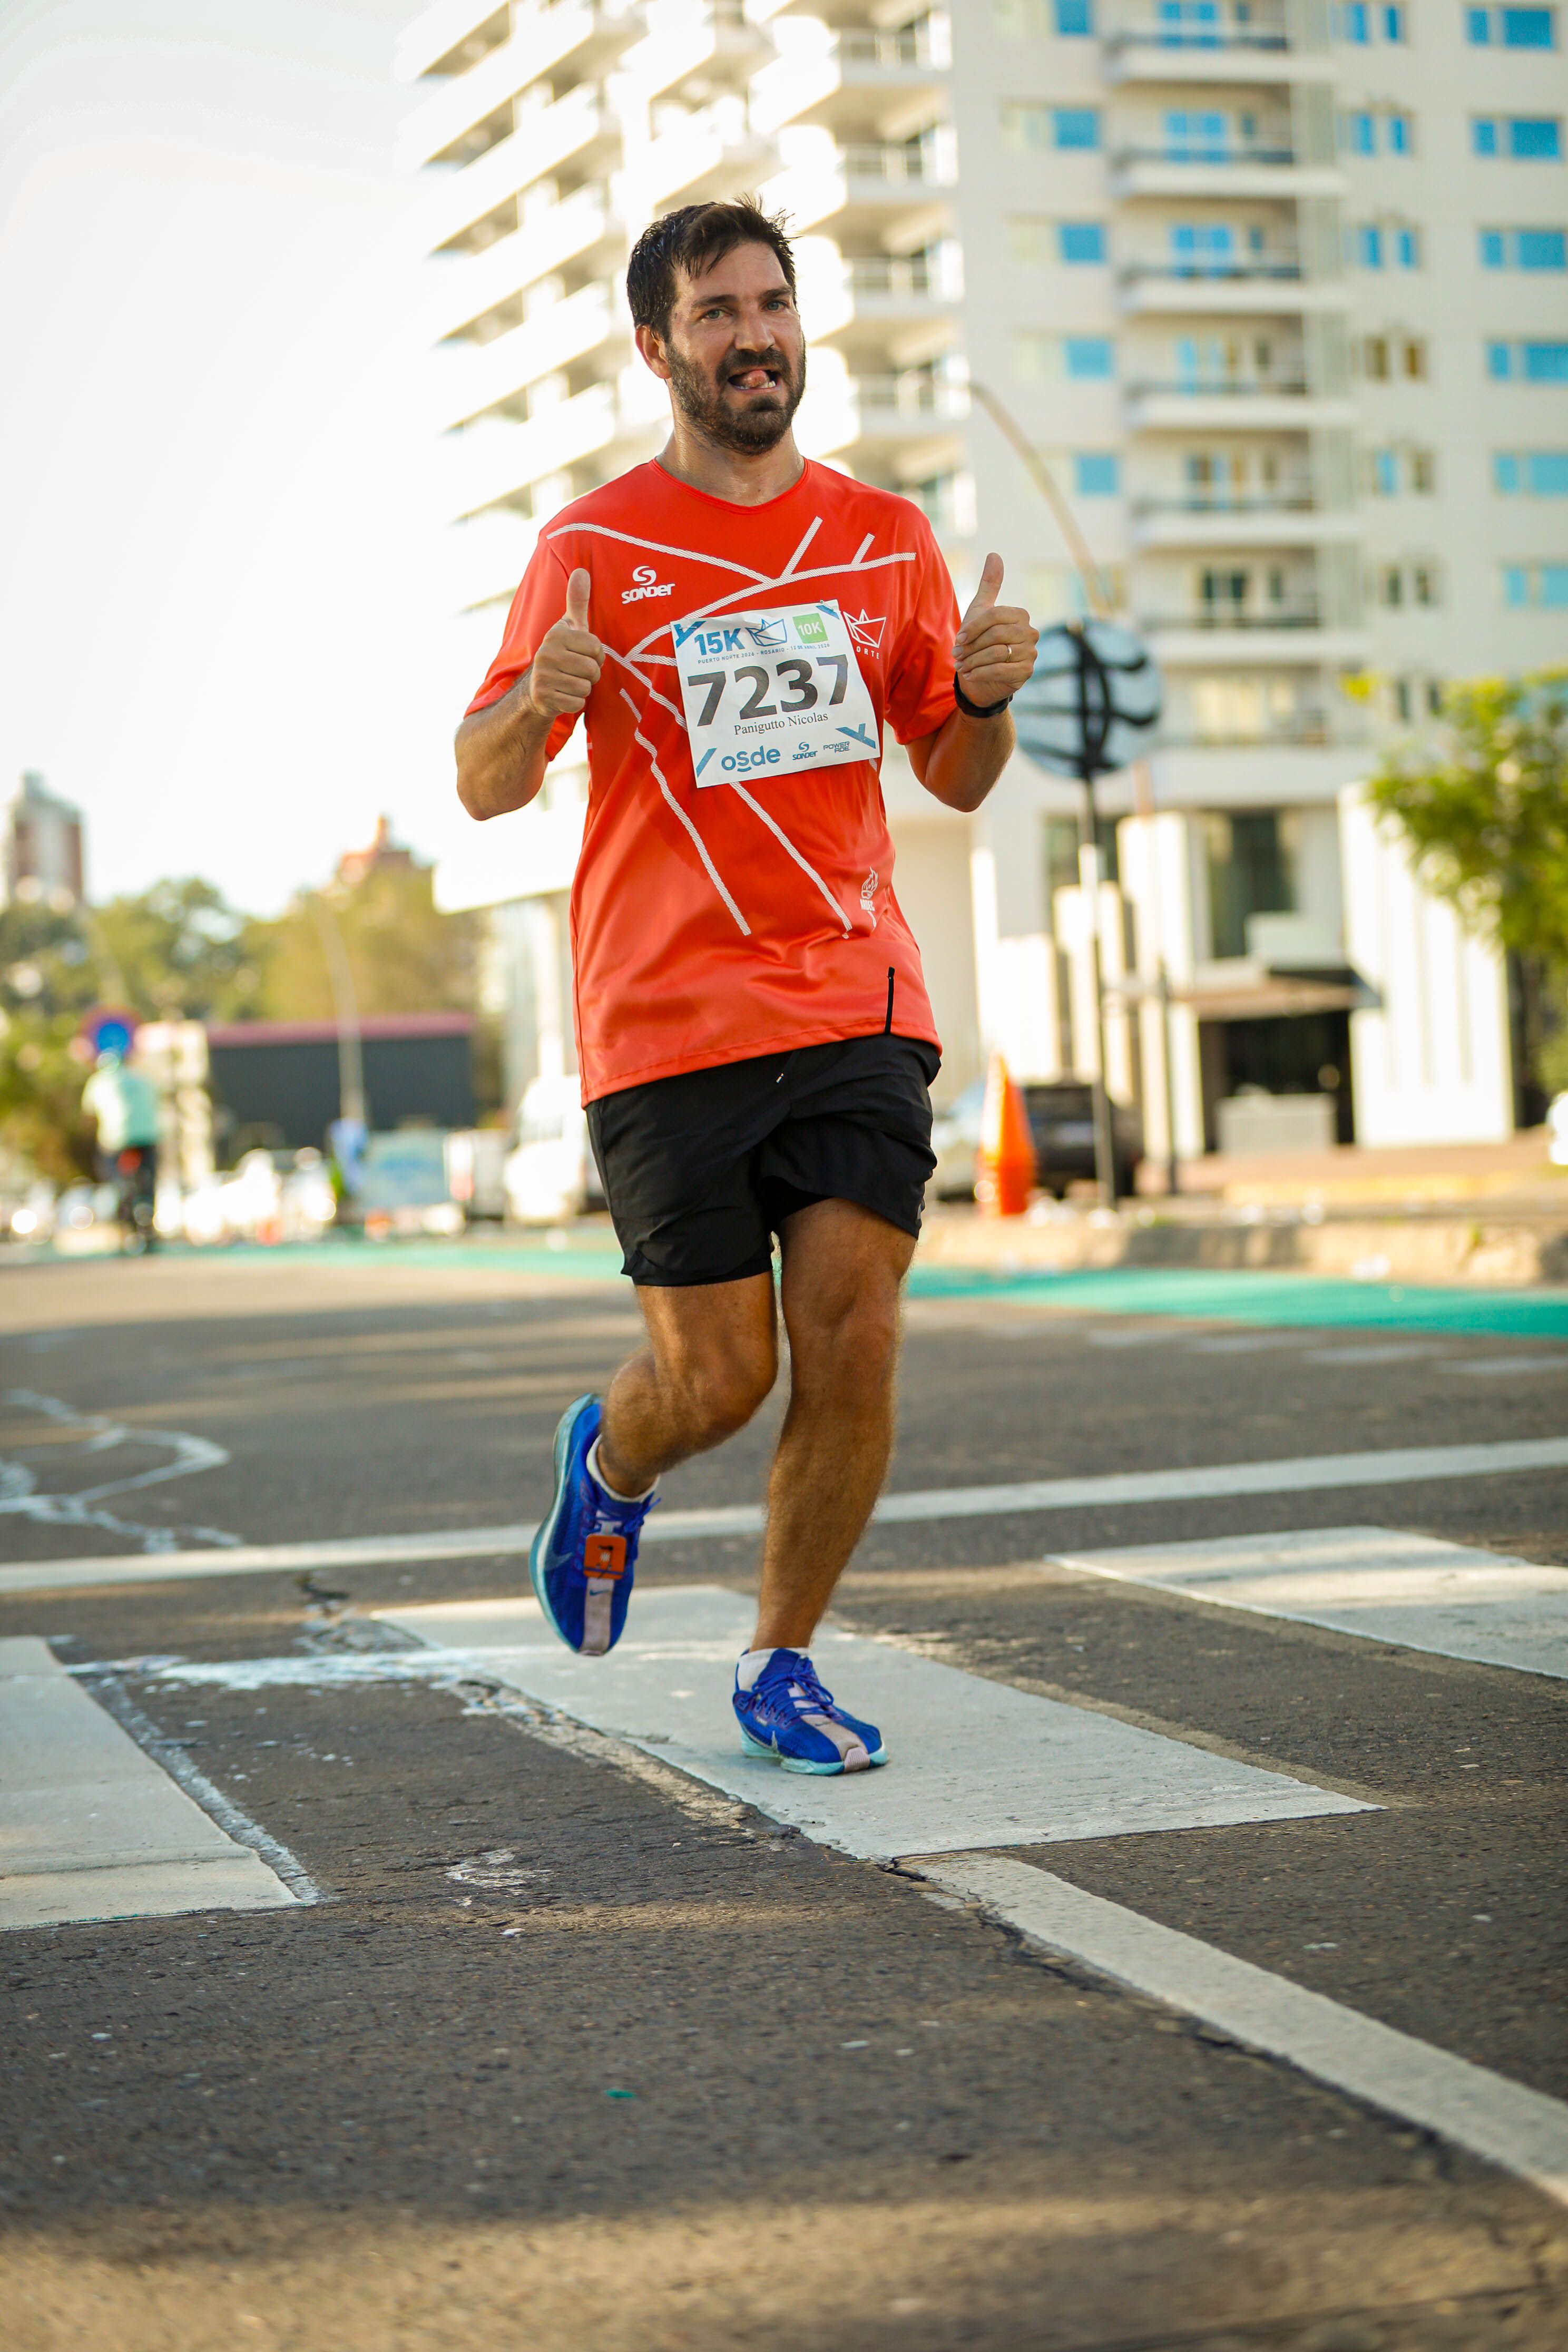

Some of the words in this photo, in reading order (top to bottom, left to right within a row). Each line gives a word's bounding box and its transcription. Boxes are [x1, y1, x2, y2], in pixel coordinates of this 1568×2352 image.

[798, 621, 823, 636] 10K
[694, 628, 746, 655] 15K
[856, 645, 880, 660] ORTE
[687, 654, 849, 727] 7237
[734, 719, 785, 735] Panigutto
[787, 712, 829, 727] Nicolas
[823, 741, 850, 751] POWER
[721, 744, 781, 772] osde
